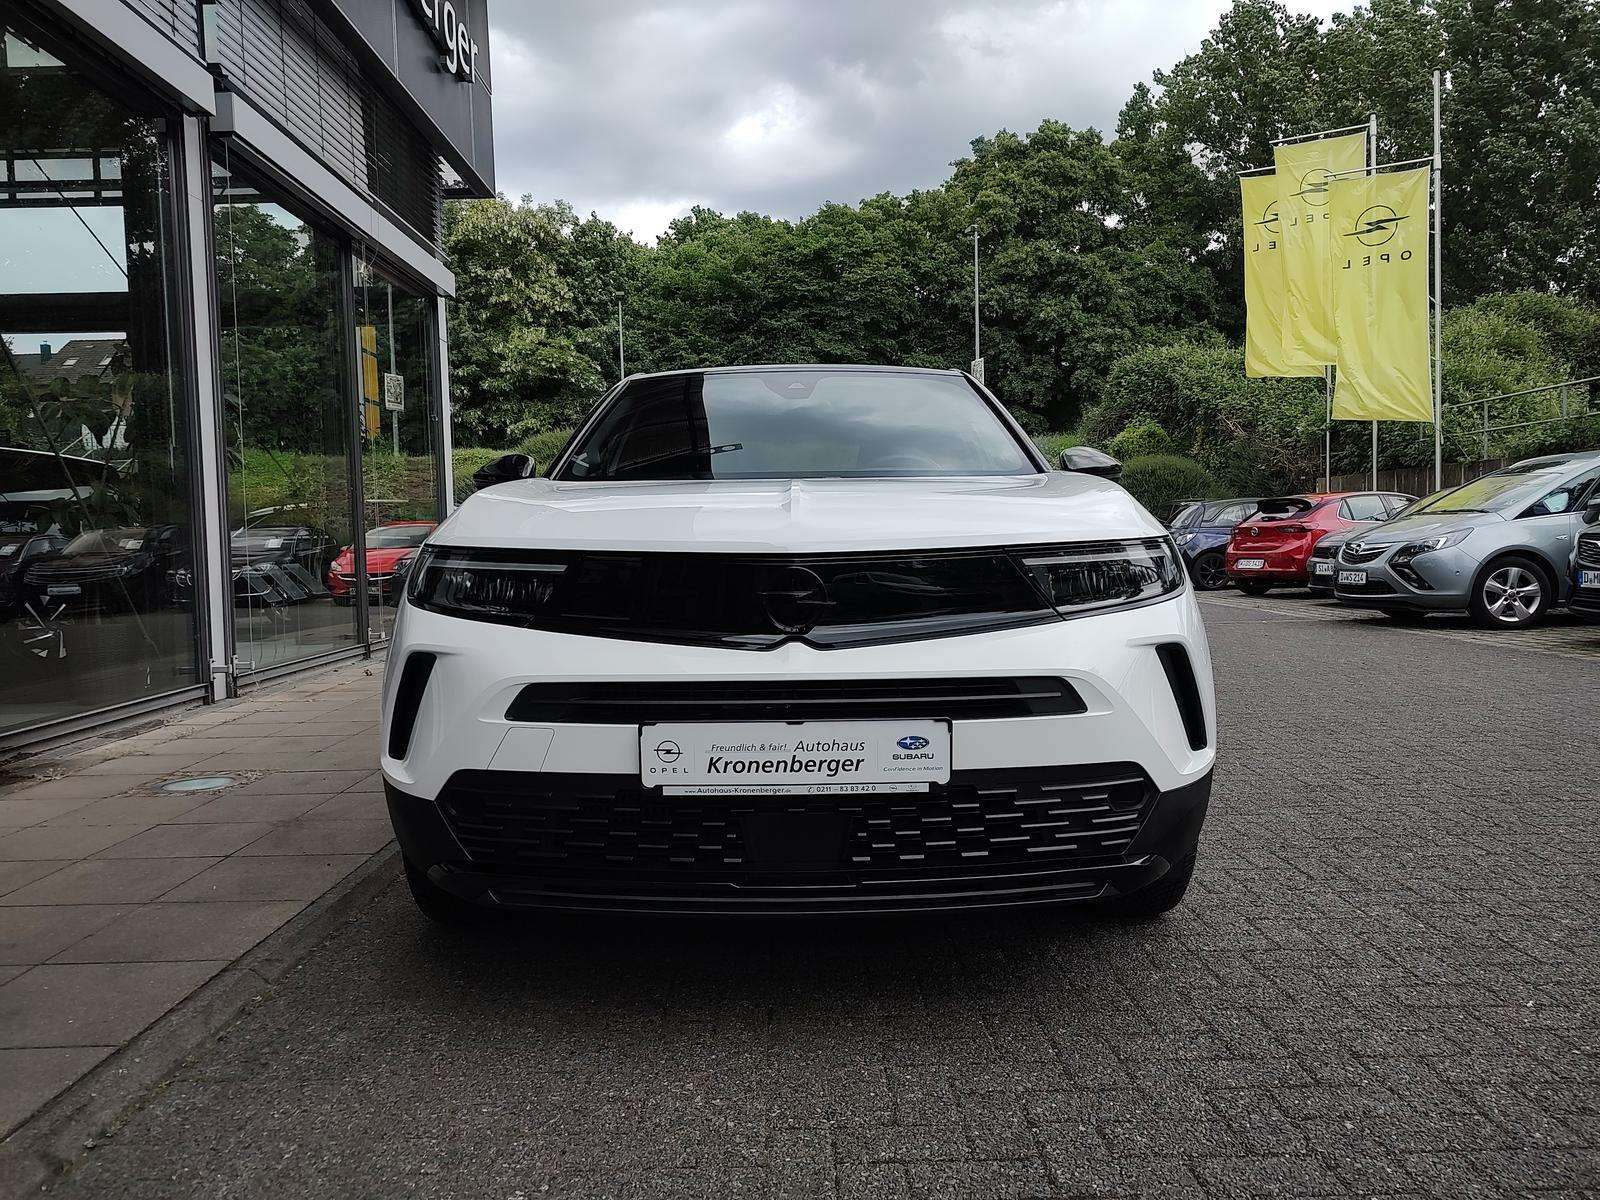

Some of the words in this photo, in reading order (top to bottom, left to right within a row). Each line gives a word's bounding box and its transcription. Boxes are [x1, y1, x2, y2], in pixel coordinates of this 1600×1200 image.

[759, 743, 766, 752] &
[768, 742, 787, 751] fair!
[794, 739, 865, 752] Autohaus
[707, 755, 865, 777] Kronenberger
[816, 785, 832, 793] 0211
